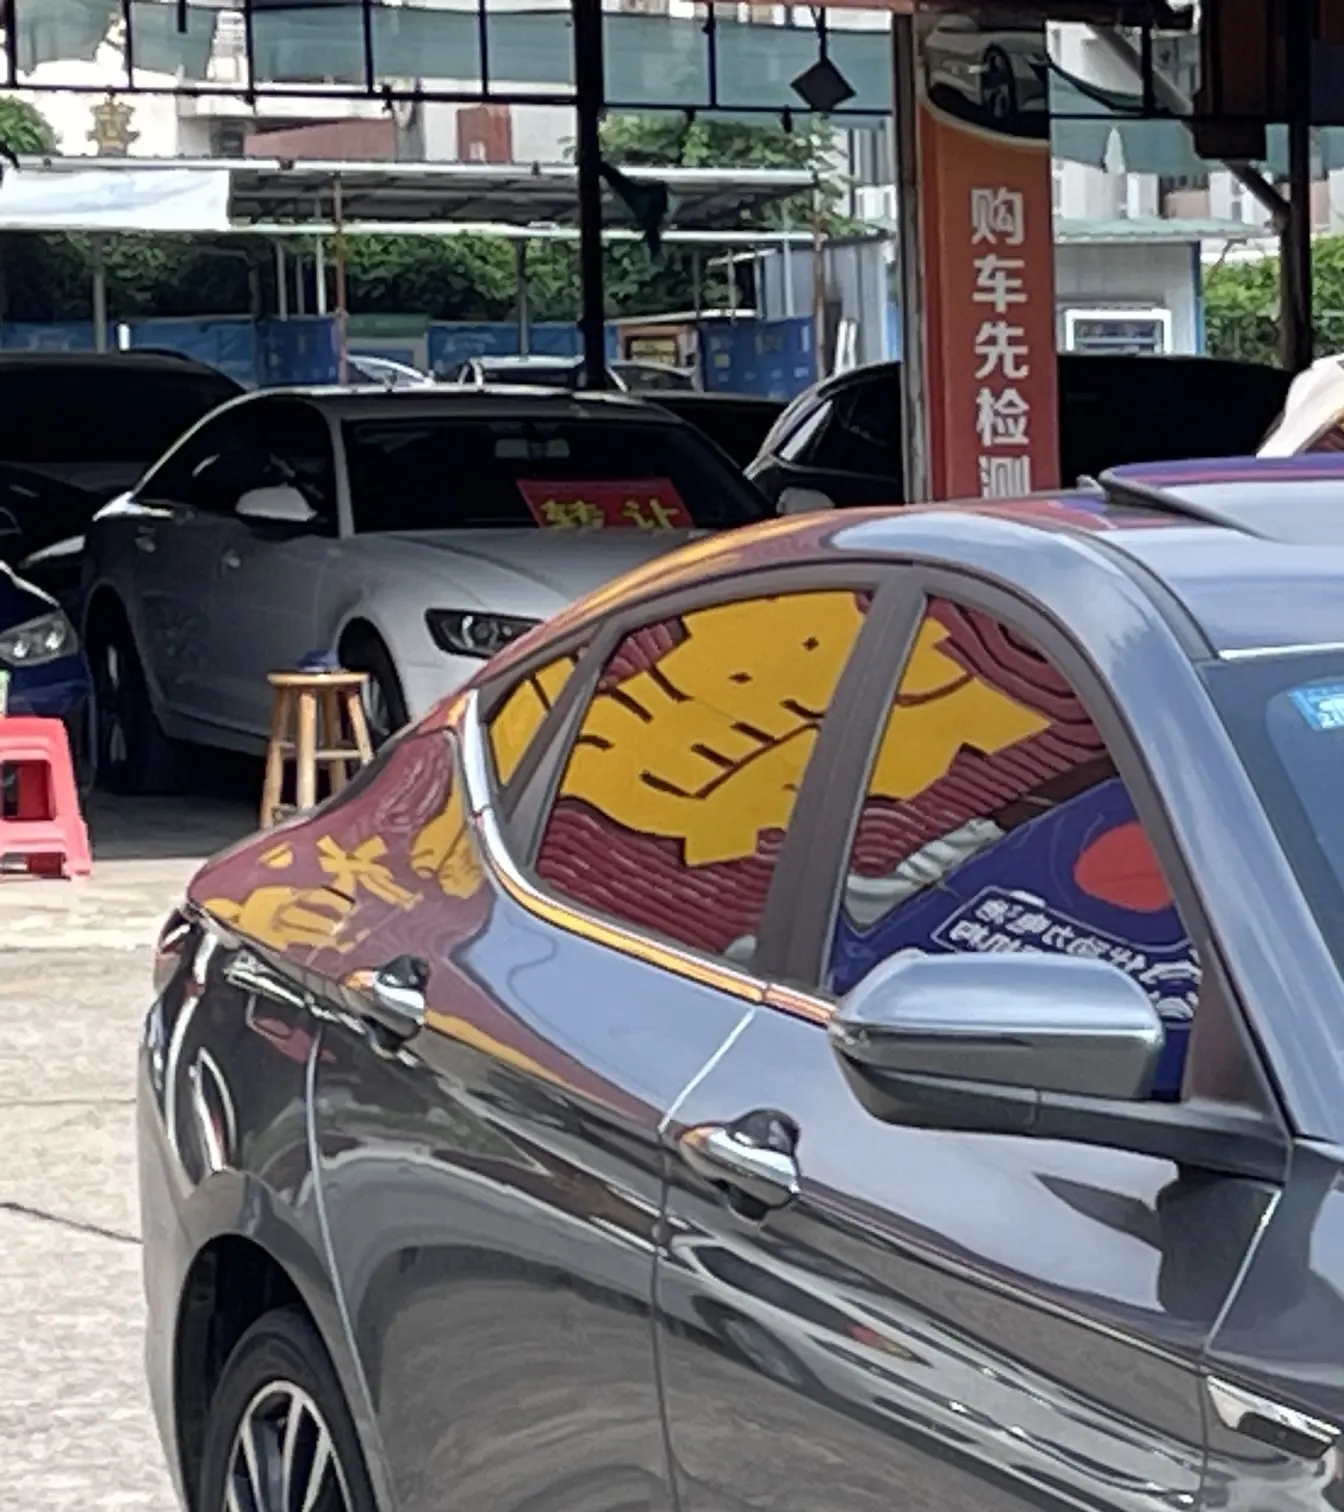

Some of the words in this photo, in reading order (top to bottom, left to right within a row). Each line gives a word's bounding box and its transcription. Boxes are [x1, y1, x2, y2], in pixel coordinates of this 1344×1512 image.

[970, 186, 1031, 499] 购车先检测
